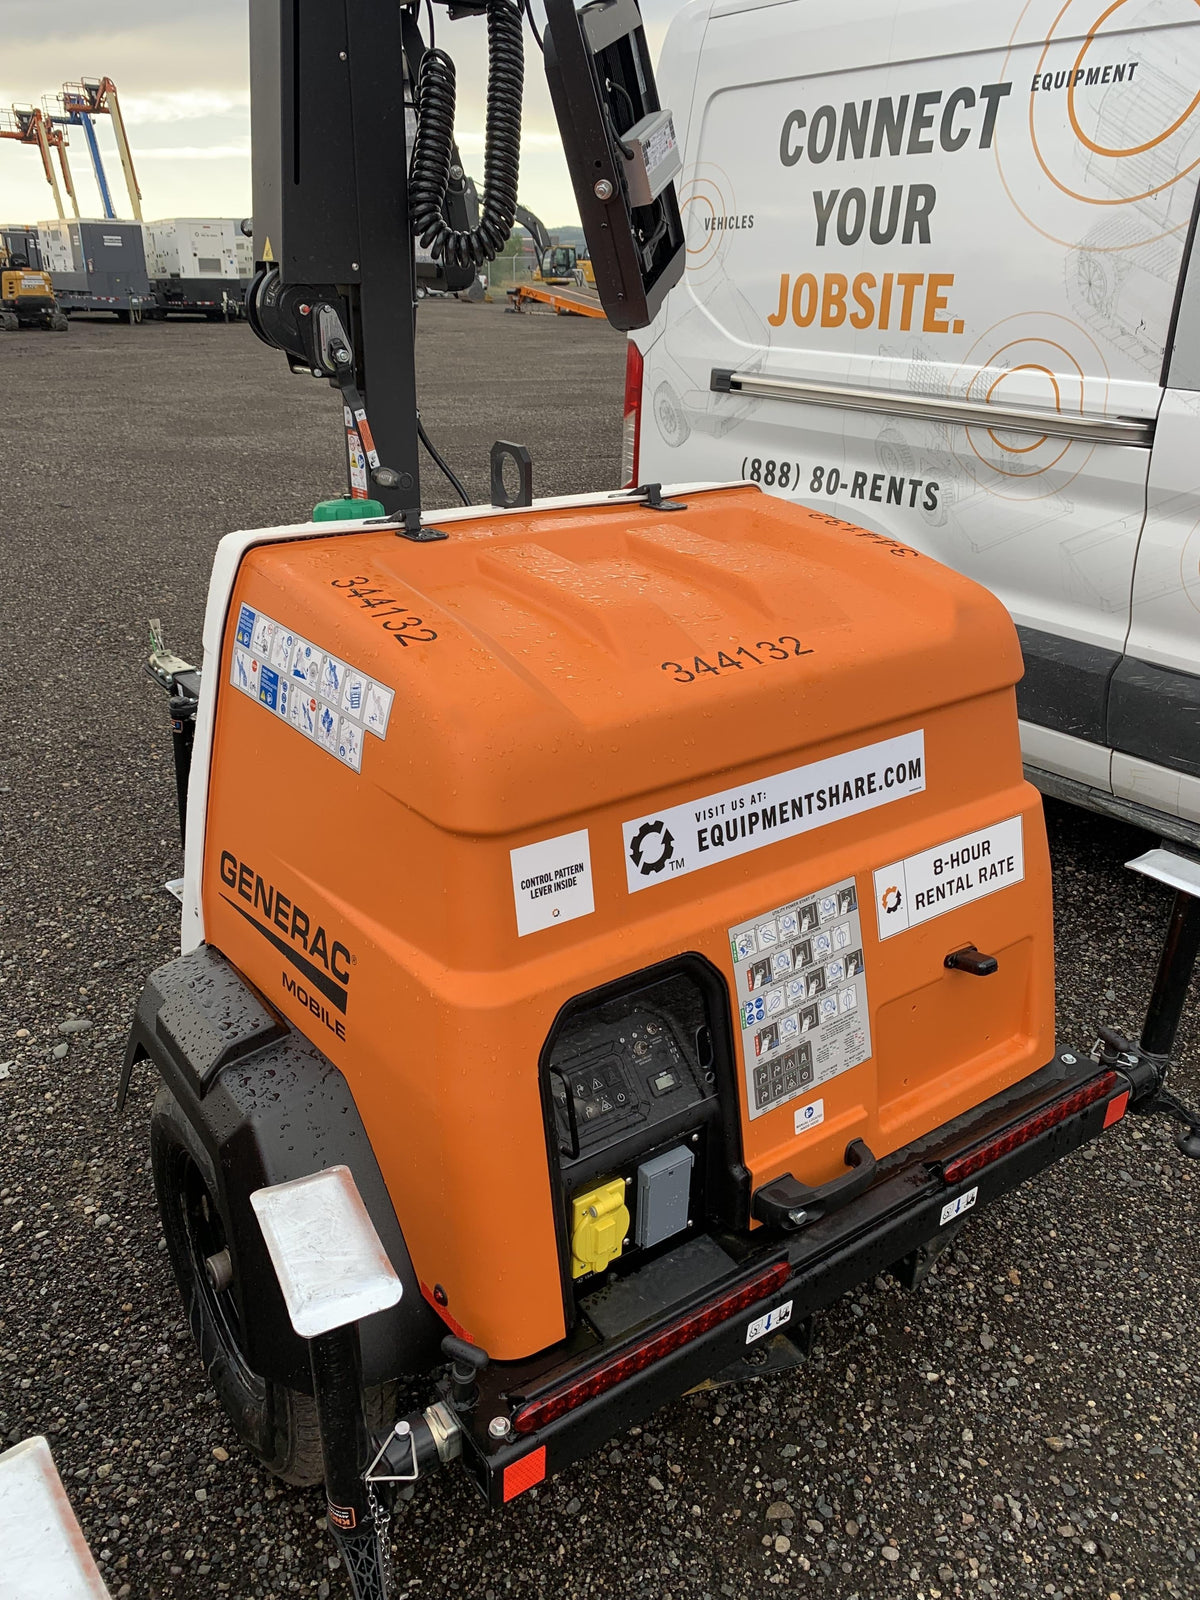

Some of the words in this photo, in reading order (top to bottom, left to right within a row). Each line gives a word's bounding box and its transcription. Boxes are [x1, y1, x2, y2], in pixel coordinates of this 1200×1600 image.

[1030, 63, 1139, 92] EQUIPMENT
[779, 82, 1013, 167] CONNECT
[703, 214, 755, 231] VEHICLES
[813, 183, 937, 246] YOUR
[767, 272, 965, 335] JOBSITE.
[741, 456, 801, 492] (888)
[809, 465, 940, 511] 80-RENTS
[331, 576, 438, 647] 344132
[661, 636, 815, 683] 344132
[694, 803, 726, 823] VISIT
[731, 797, 746, 812] US
[750, 791, 767, 806] AT:
[697, 757, 922, 852] EQUIPMENTSHARE.COM
[520, 872, 554, 890] CONTROL
[554, 862, 585, 880] PATTERN
[915, 873, 974, 910] RENTAL
[978, 856, 1015, 884] RATE
[933, 840, 991, 876] 8-HOUR
[530, 884, 553, 900] LEVER
[554, 876, 578, 893] INSIDE
[220, 850, 351, 985] GENERAC
[282, 971, 346, 1042] MOBILE
